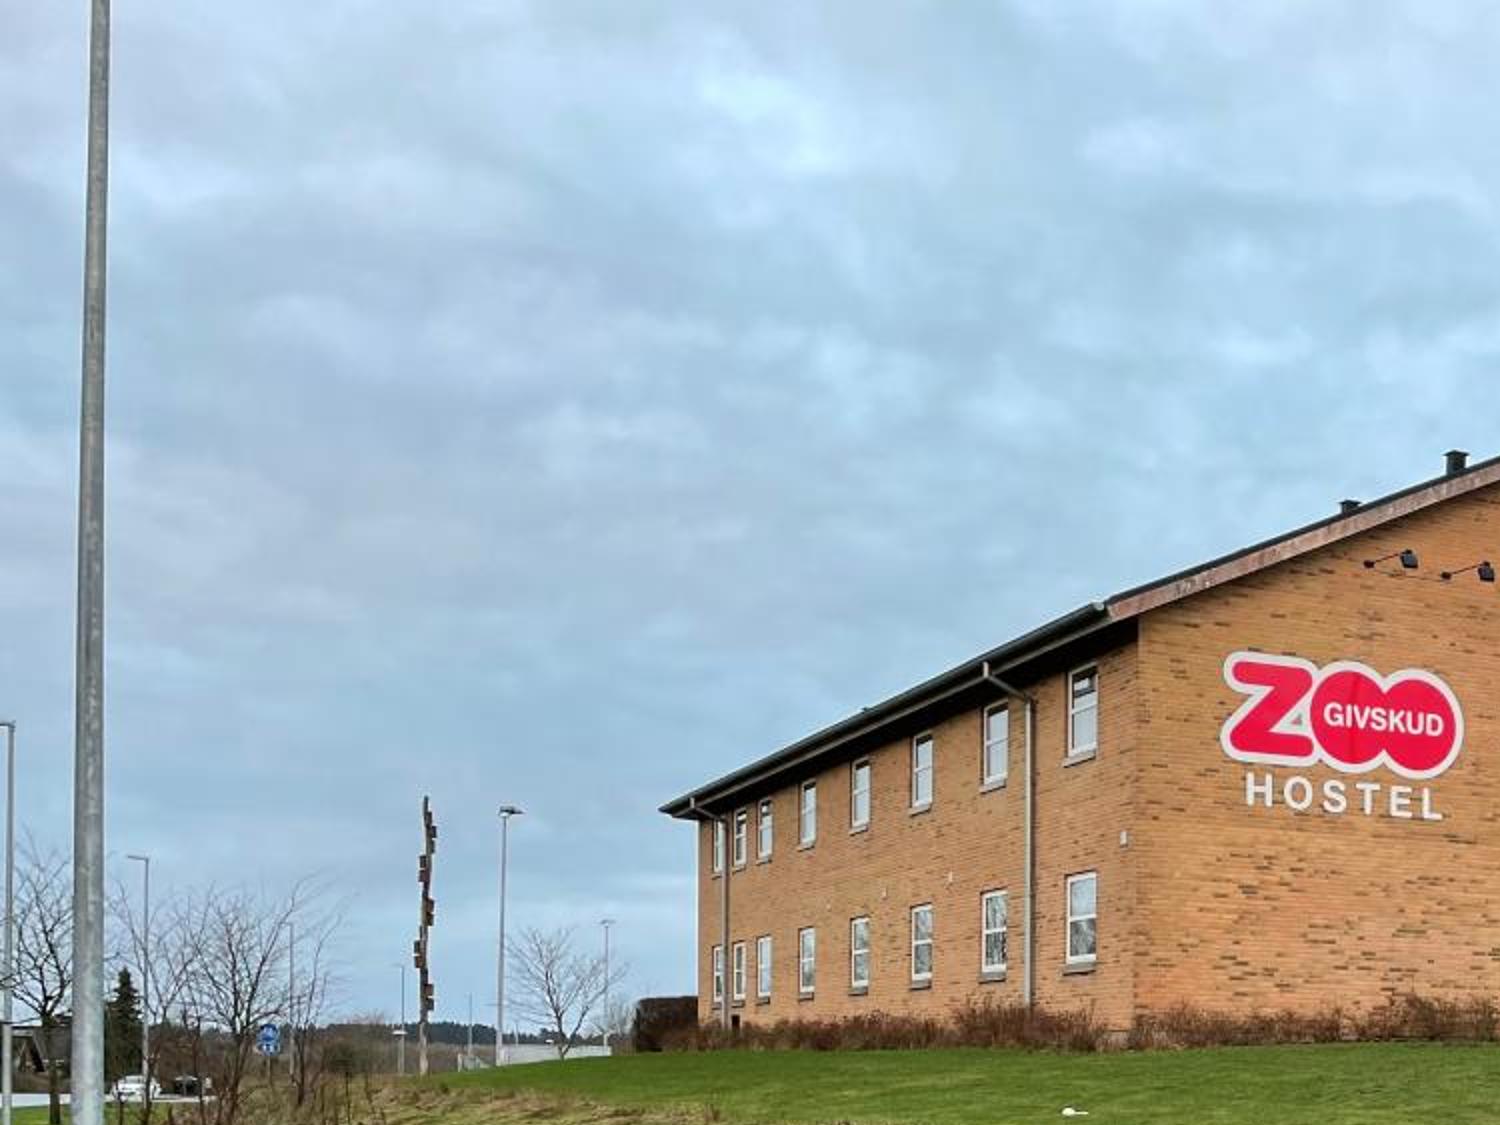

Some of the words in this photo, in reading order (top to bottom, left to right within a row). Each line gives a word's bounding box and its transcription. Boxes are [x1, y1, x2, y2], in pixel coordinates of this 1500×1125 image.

[1228, 659, 1458, 772] ZOO
[1322, 701, 1445, 738] GIVSKUD
[1245, 771, 1444, 822] HOSTEL
